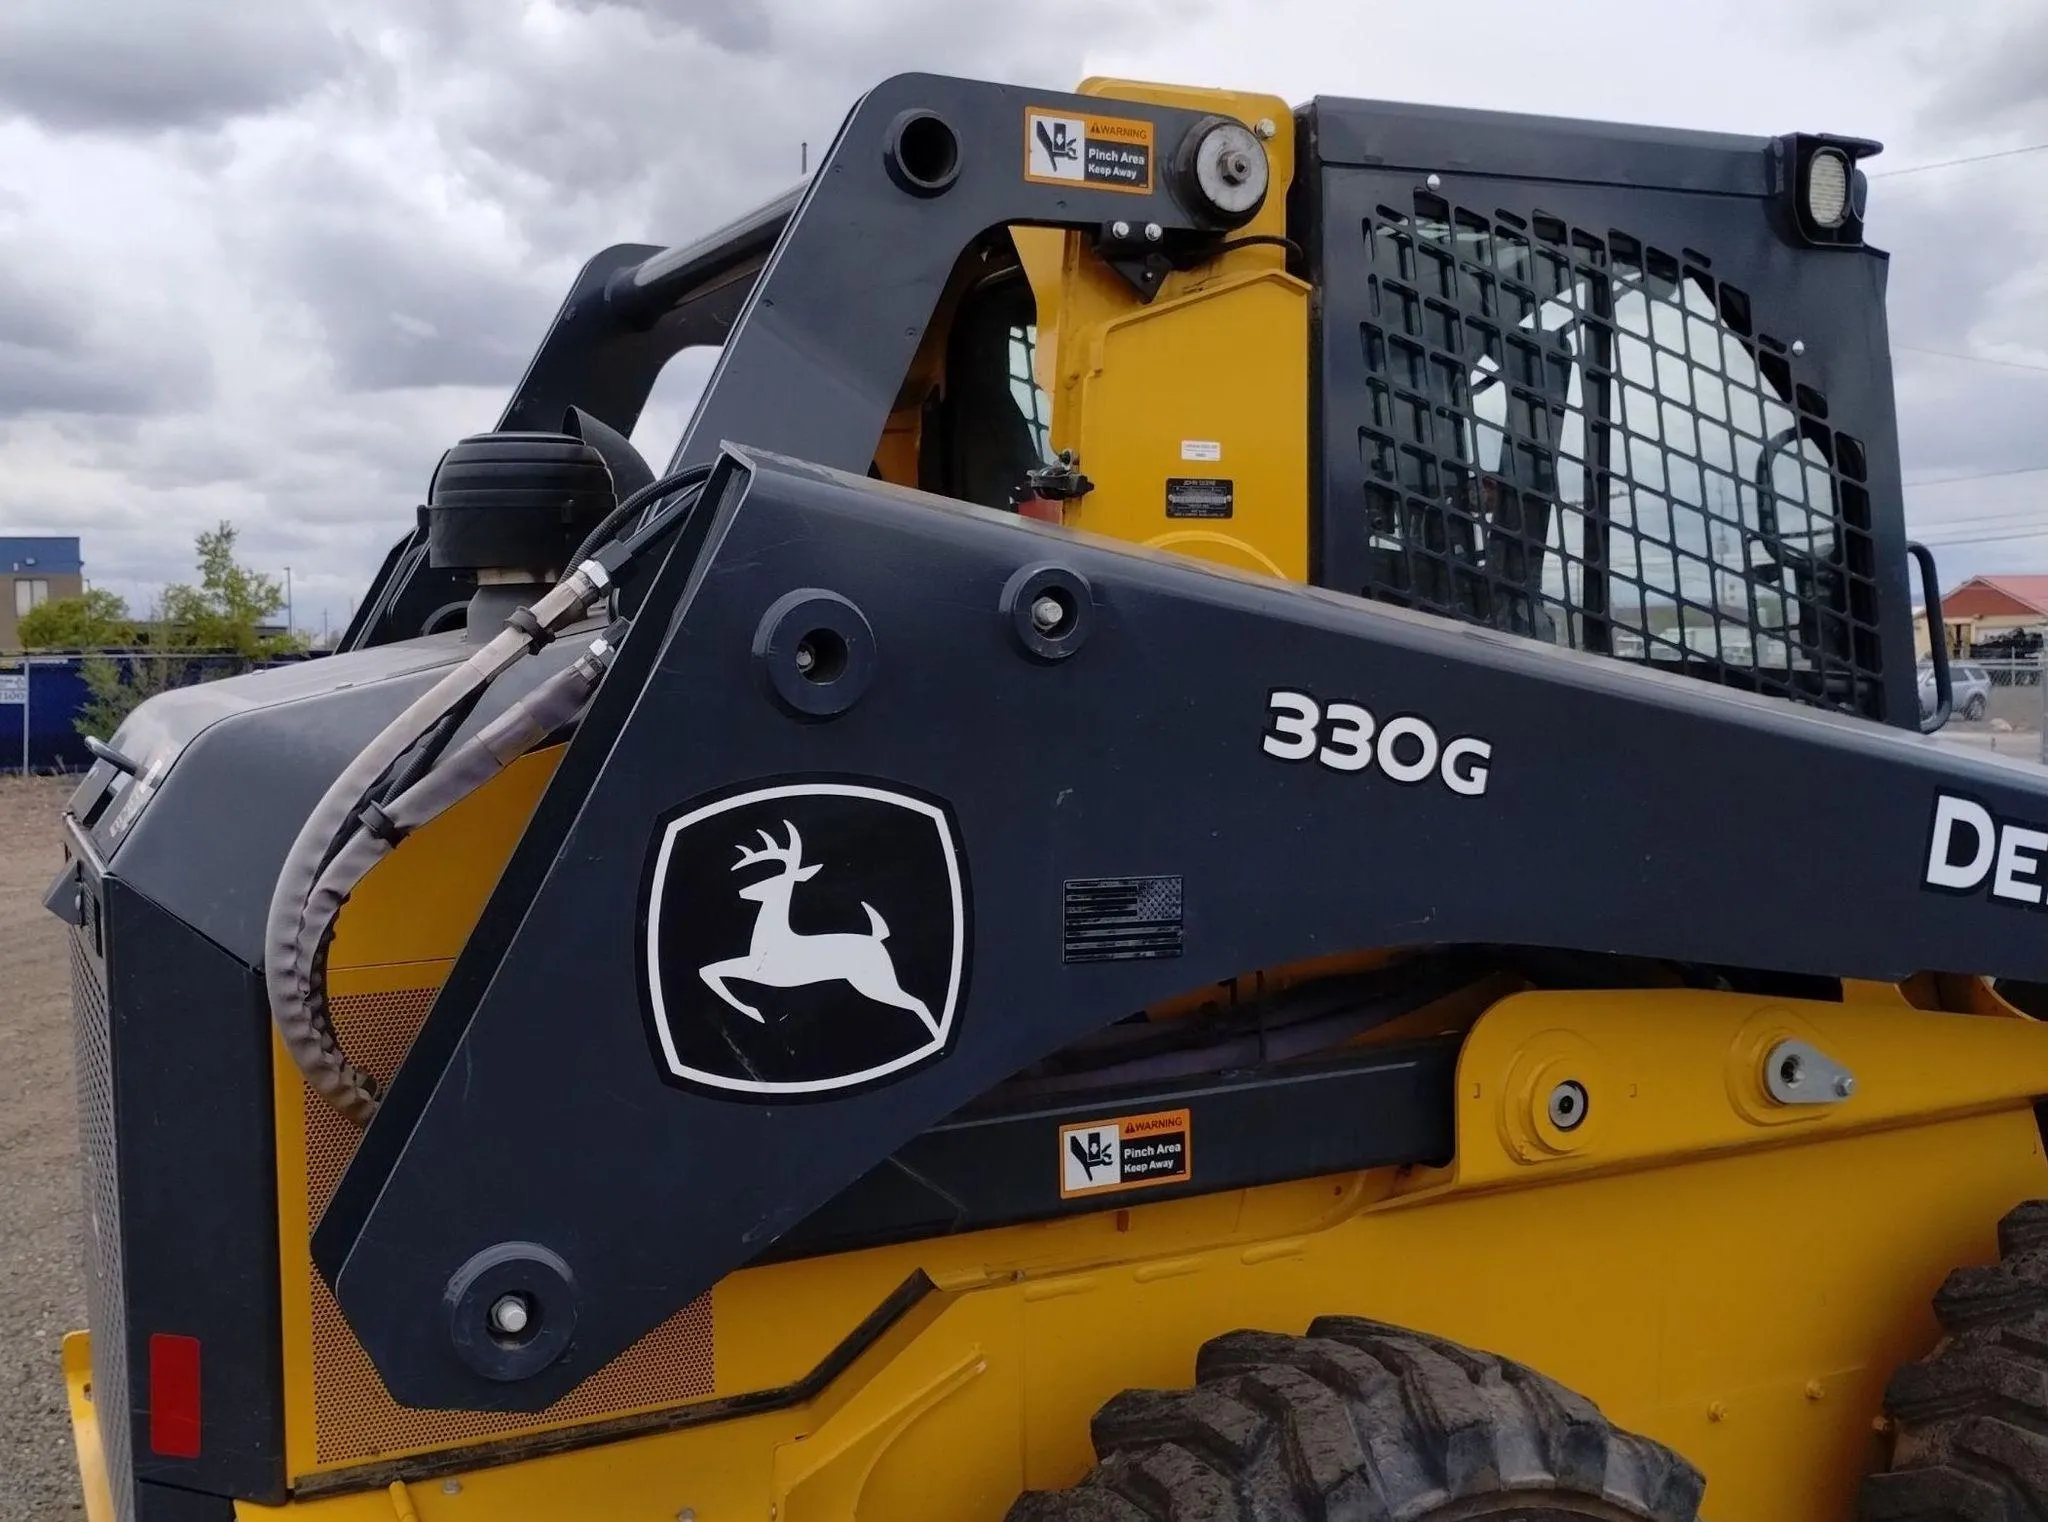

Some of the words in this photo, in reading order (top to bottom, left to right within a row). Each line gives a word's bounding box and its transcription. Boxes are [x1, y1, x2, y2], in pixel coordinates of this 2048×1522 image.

[1101, 124, 1147, 140] WARNING
[1088, 148, 1118, 162] Pinch
[1120, 152, 1145, 165] Area
[1088, 163, 1111, 177] Keep
[1113, 166, 1137, 180] Away
[1263, 691, 1492, 796] 330G
[1926, 794, 2048, 905] DE
[1135, 1117, 1183, 1132] WARNING
[1124, 1145, 1155, 1160] Pinch
[1156, 1143, 1182, 1156] Area
[1124, 1162, 1148, 1174] Keep
[1149, 1159, 1174, 1172] Away
